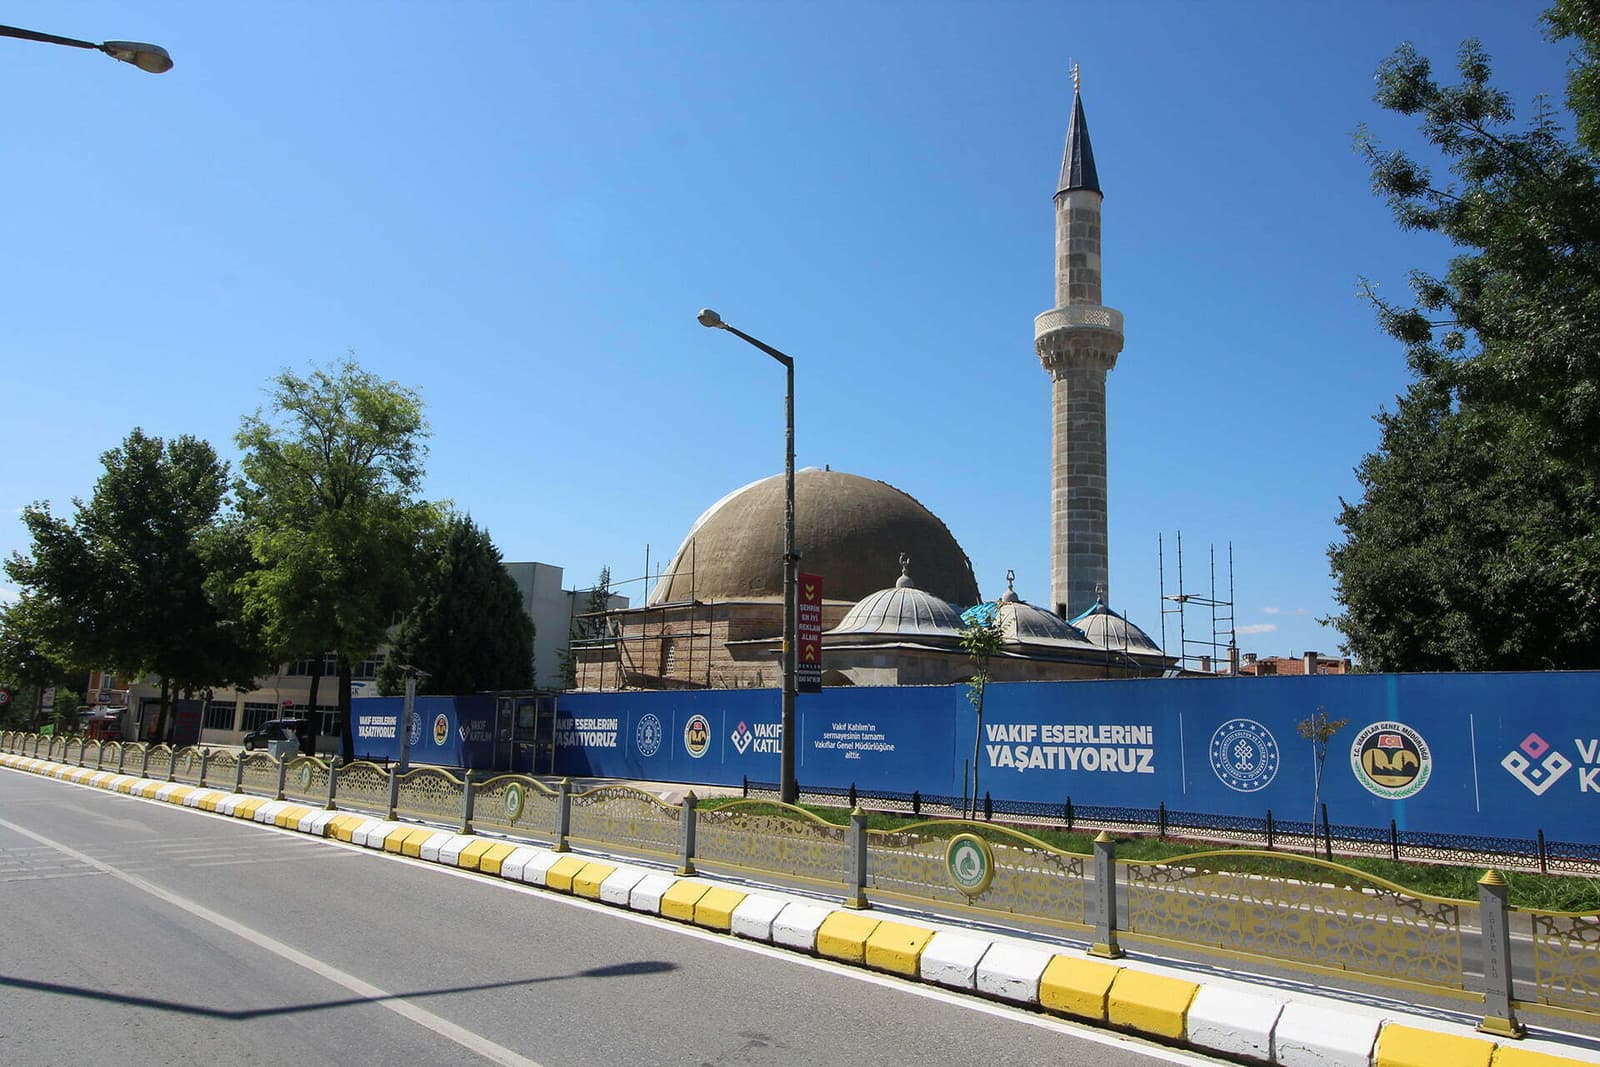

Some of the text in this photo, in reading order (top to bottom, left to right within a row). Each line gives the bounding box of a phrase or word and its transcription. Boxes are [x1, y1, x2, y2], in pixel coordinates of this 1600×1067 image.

[556, 718, 574, 730] AKIF
[753, 723, 783, 738] VAKIF
[831, 722, 847, 731] Vakıf
[1380, 723, 1400, 732] GENEL
[823, 732, 885, 741] sermayesinin tamamı
[985, 724, 1037, 743] VAKIF
[753, 739, 783, 753] KATIL
[814, 740, 896, 753] Vakıflar Genel Müdürlüğüne
[985, 744, 1155, 773] YAŞATIYORUZ
